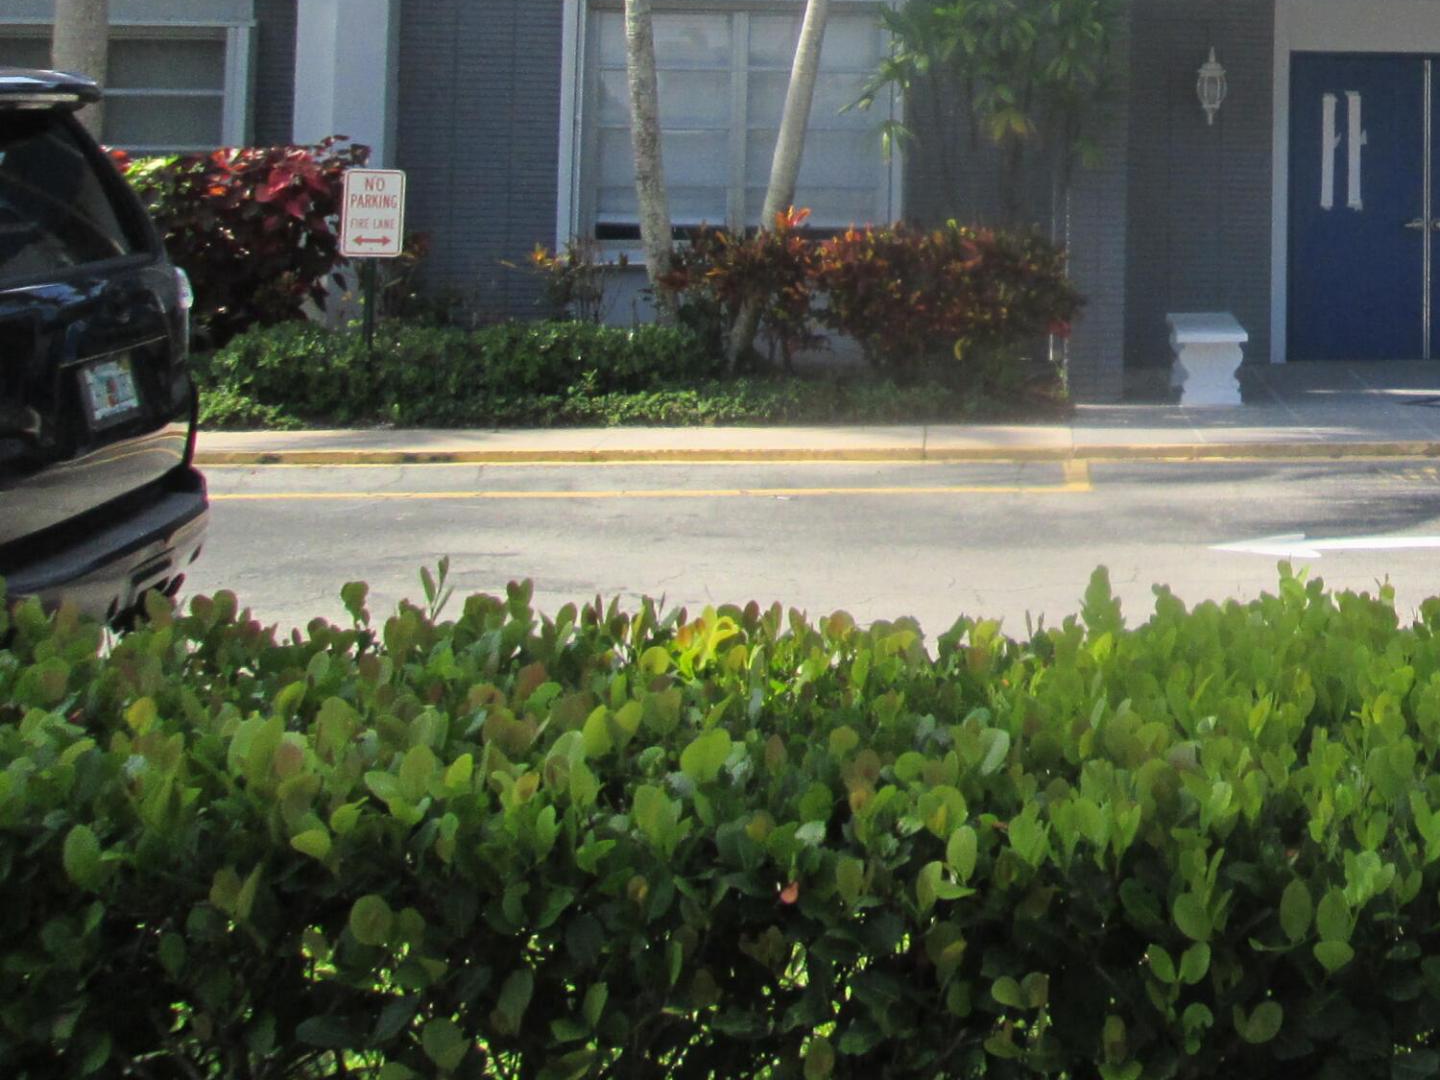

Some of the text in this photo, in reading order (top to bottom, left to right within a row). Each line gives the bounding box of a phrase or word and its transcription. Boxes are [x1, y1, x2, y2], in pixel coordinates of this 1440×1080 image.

[364, 177, 385, 192] NO
[350, 193, 398, 209] PARKING
[350, 218, 395, 230] FIRE LANE
